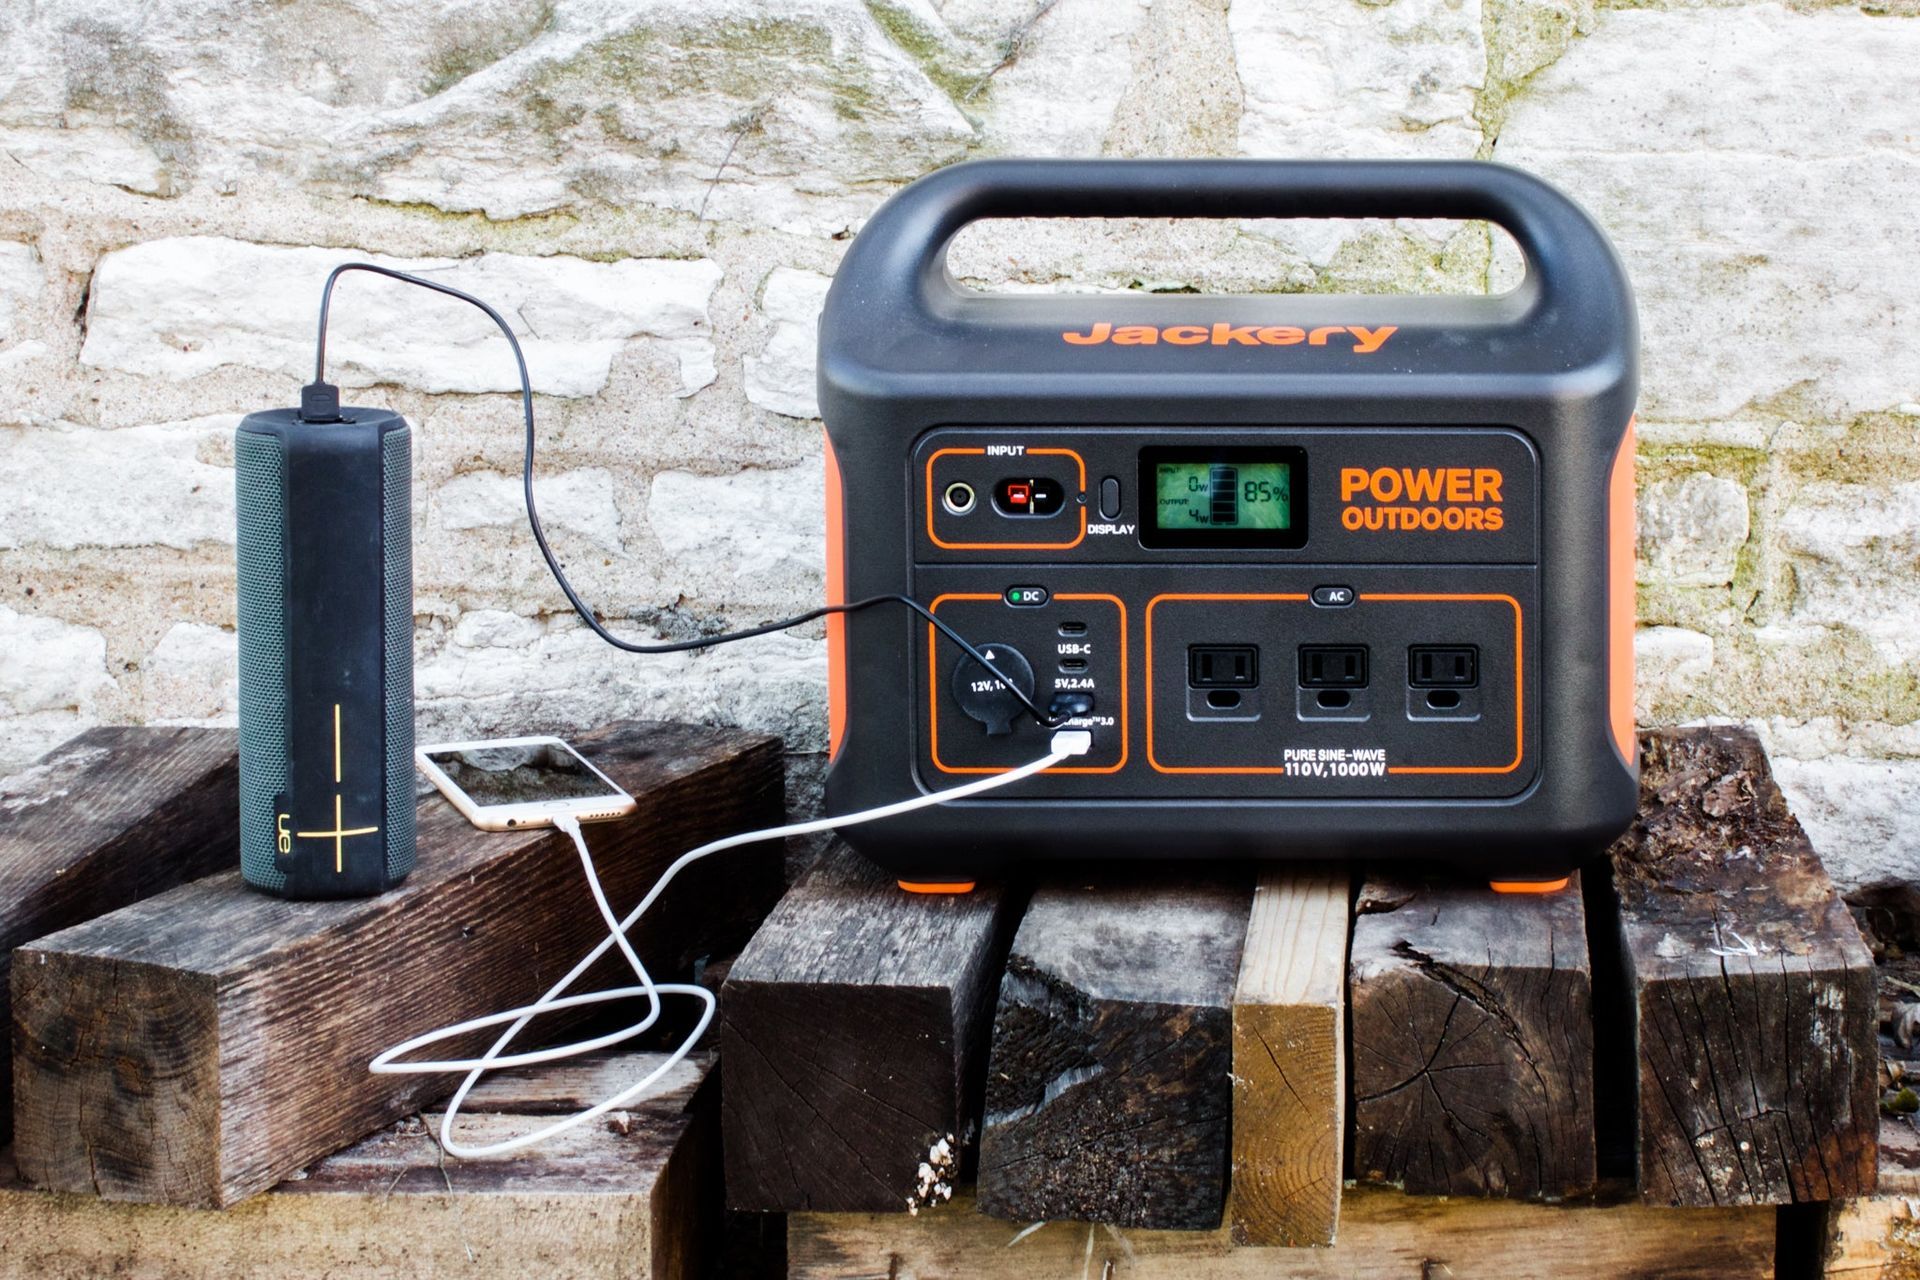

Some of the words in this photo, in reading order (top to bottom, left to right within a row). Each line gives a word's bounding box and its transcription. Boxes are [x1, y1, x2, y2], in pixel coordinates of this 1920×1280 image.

[1062, 322, 1399, 354] Jackery
[987, 445, 1024, 456] INPUT
[1340, 467, 1504, 502] POWER
[1244, 481, 1289, 503] 85%
[1341, 506, 1505, 531] OUTDOORS
[1087, 524, 1135, 535] DISPLAY
[1023, 591, 1039, 601] DC
[1329, 591, 1345, 601] AC
[1057, 643, 1091, 654] USB-C
[1284, 749, 1316, 761] PURE
[1318, 749, 1386, 761] SINE-WAVE
[1284, 762, 1386, 778] 110V,1000W
